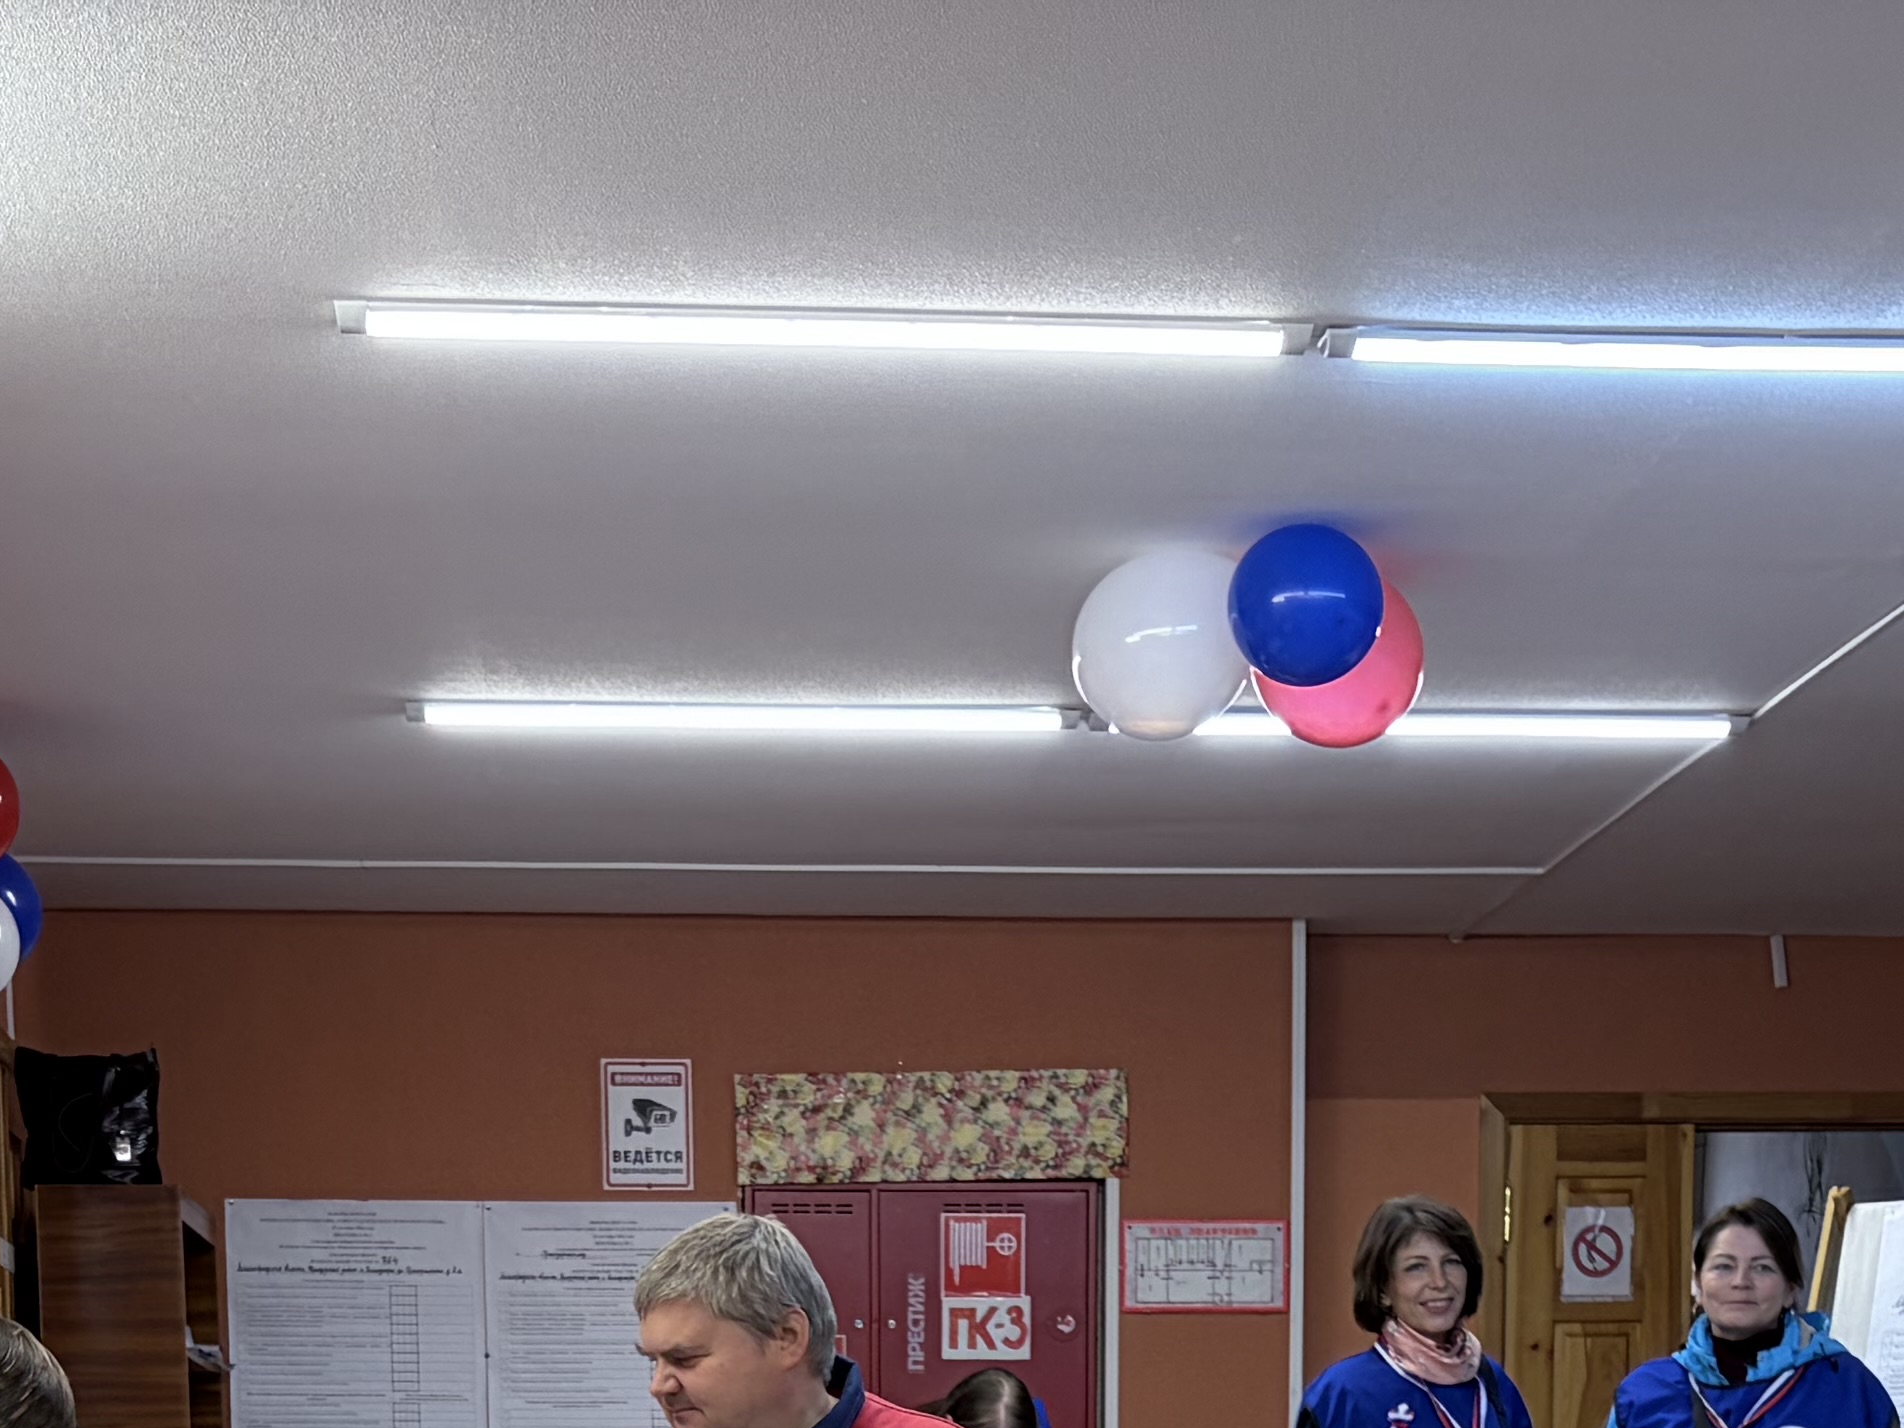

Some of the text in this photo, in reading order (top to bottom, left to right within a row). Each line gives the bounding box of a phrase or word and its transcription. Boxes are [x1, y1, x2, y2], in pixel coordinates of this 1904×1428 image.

[612, 1147, 683, 1165] ВЕДЁТСЯ
[907, 1272, 925, 1374] ПРЕСТИЖ
[949, 1305, 1028, 1350] ПК-3
